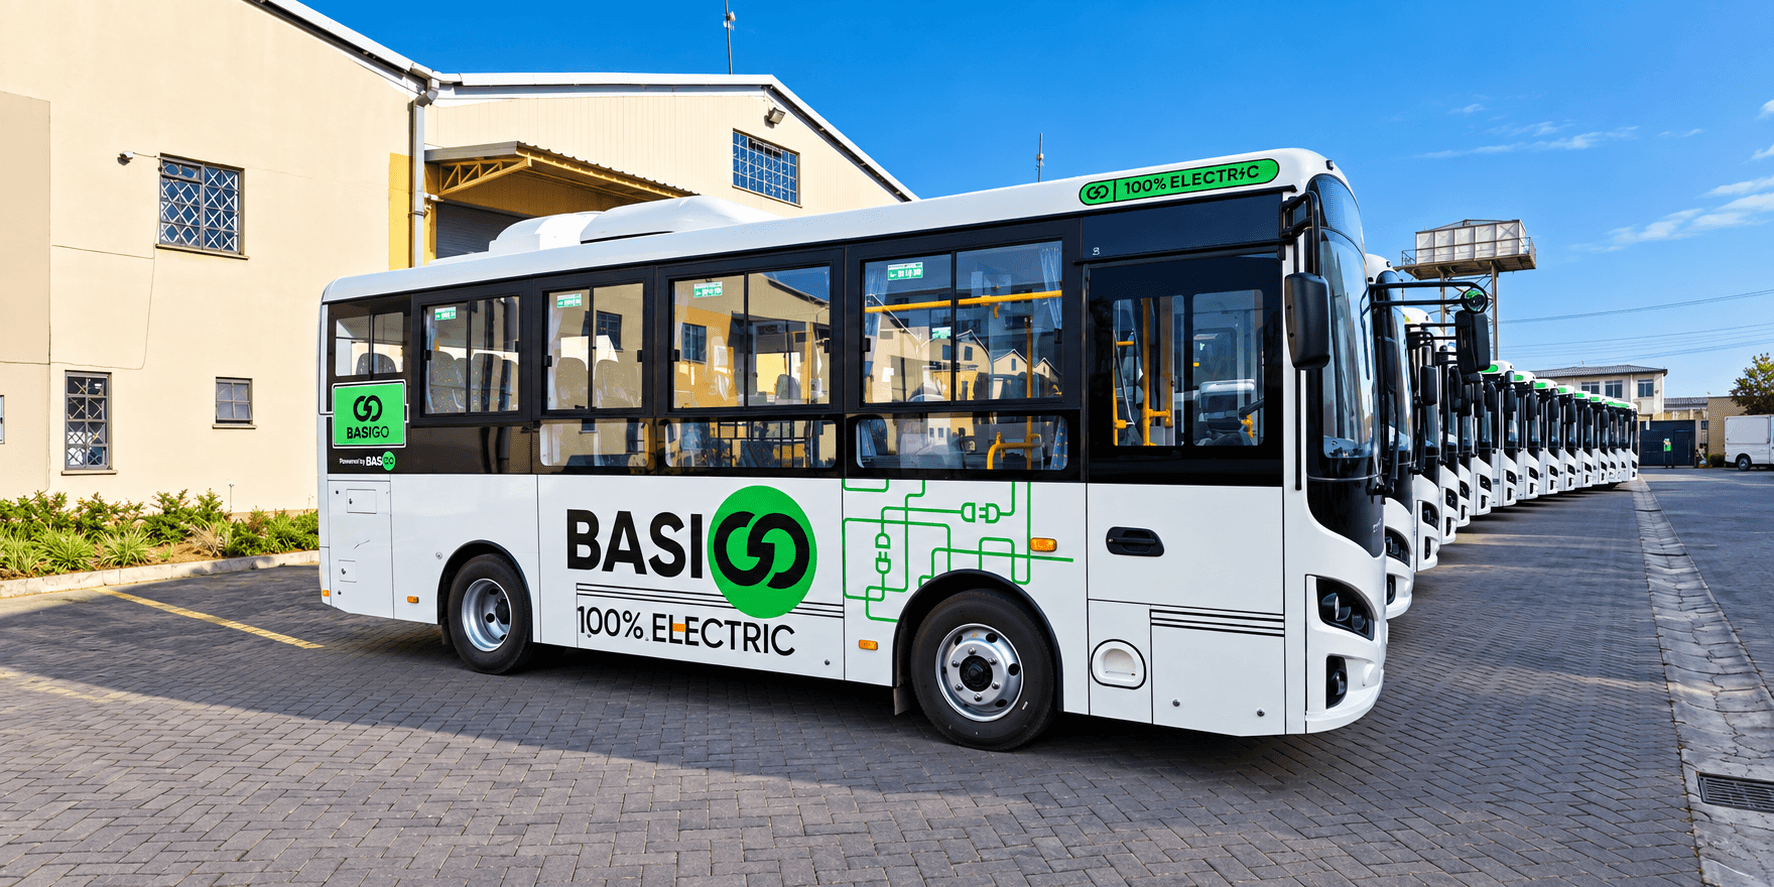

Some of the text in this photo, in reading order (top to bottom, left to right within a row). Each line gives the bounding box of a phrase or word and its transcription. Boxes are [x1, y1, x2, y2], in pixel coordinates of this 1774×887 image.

[1124, 178, 1167, 195] 100%
[346, 425, 390, 439] BASIGO
[577, 605, 796, 656] 100% ELECTRIC
